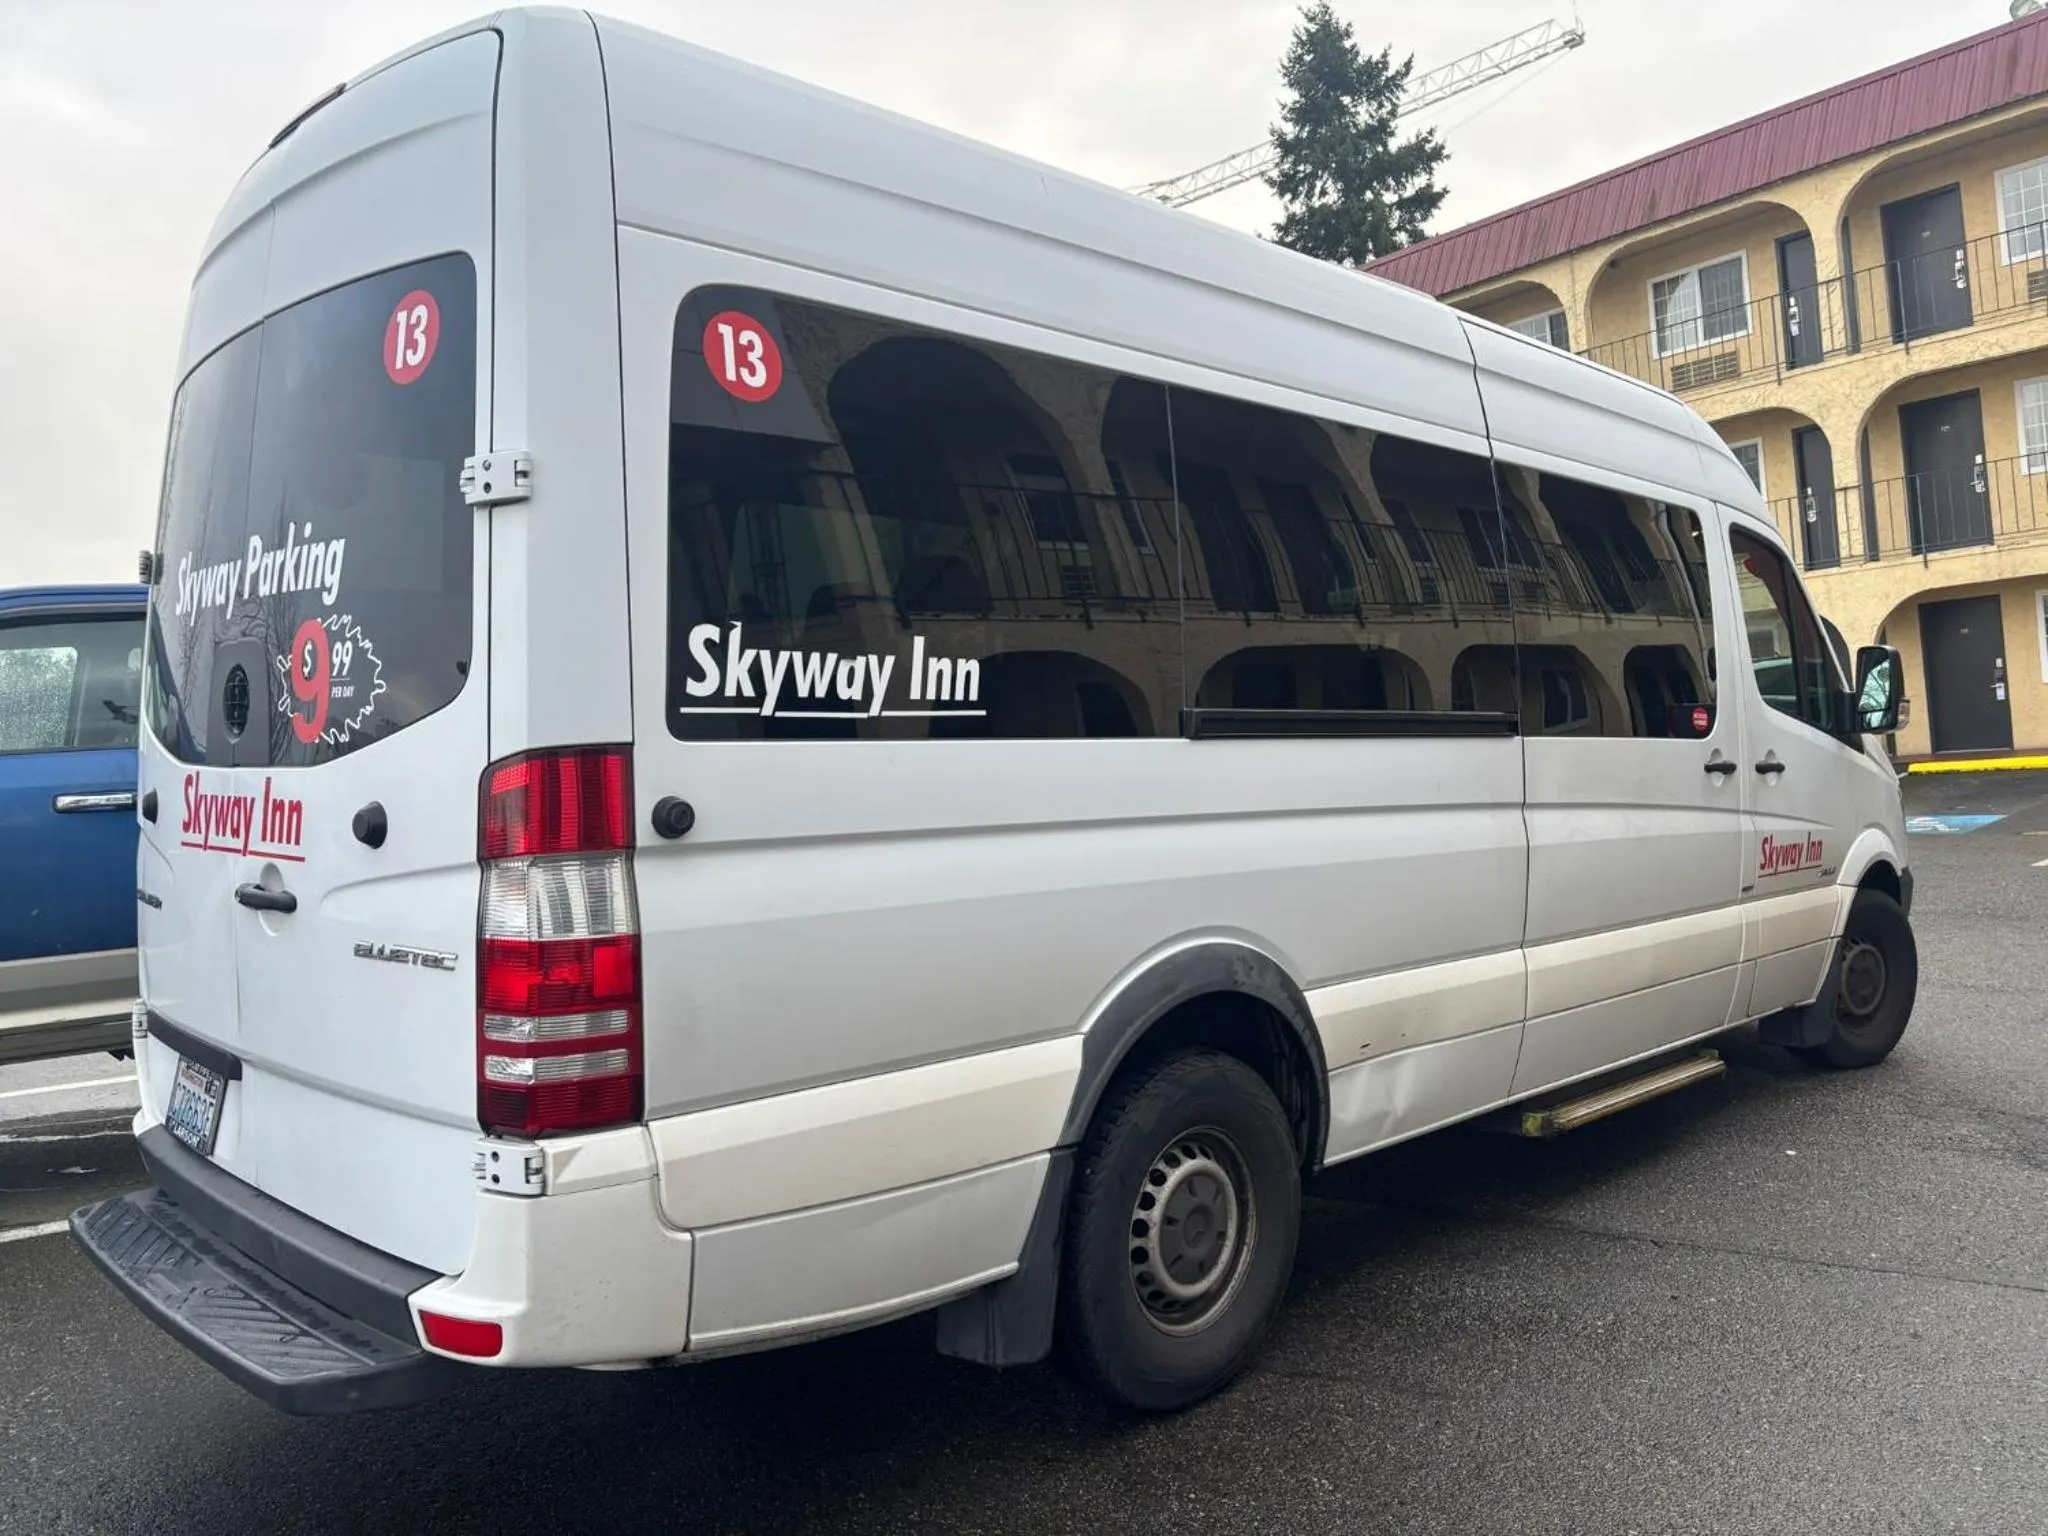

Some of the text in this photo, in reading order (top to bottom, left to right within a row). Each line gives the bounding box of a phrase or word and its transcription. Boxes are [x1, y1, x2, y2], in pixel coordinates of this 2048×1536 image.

[396, 304, 429, 370] 13
[717, 322, 767, 388] 13
[175, 521, 346, 627] Skyway Parking
[331, 685, 355, 698] PER DAY
[686, 620, 981, 717] Skyway Inn
[182, 771, 304, 857] Skyway Inn
[1759, 831, 1823, 875] Skyway Inn
[353, 939, 459, 972] BLUETEC
